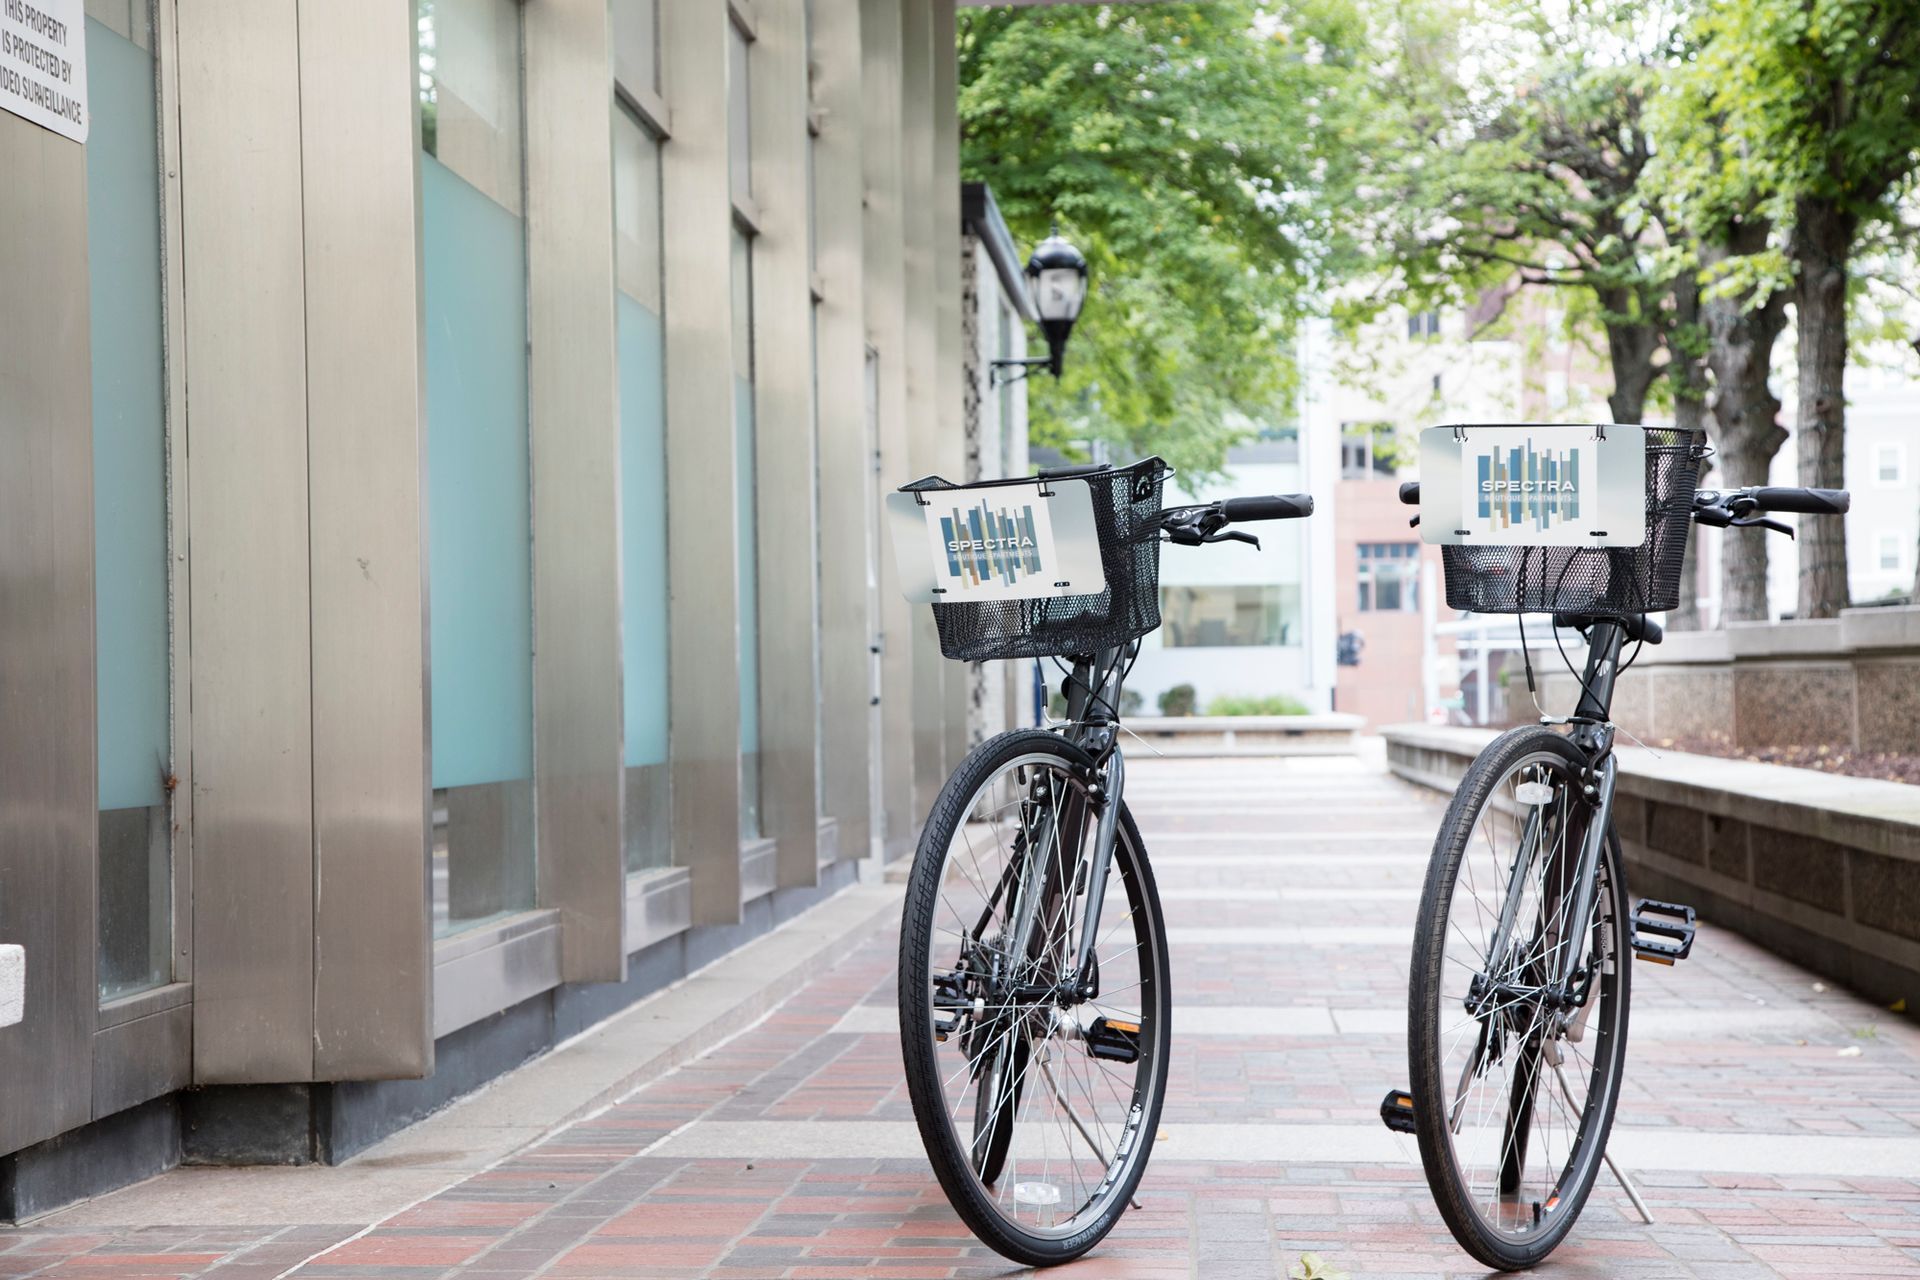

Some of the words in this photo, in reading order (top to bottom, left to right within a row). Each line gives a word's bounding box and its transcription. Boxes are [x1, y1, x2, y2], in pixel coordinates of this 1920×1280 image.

[25, 4, 67, 47] PROPERTY
[2, 29, 11, 54] IS
[13, 34, 60, 79] PROTECTED
[62, 59, 72, 84] BY
[0, 64, 20, 96] IDEO
[22, 76, 82, 125] SURVEILLANCE
[1481, 480, 1575, 492] SPECTRA
[948, 536, 1034, 551] SPECTRA
